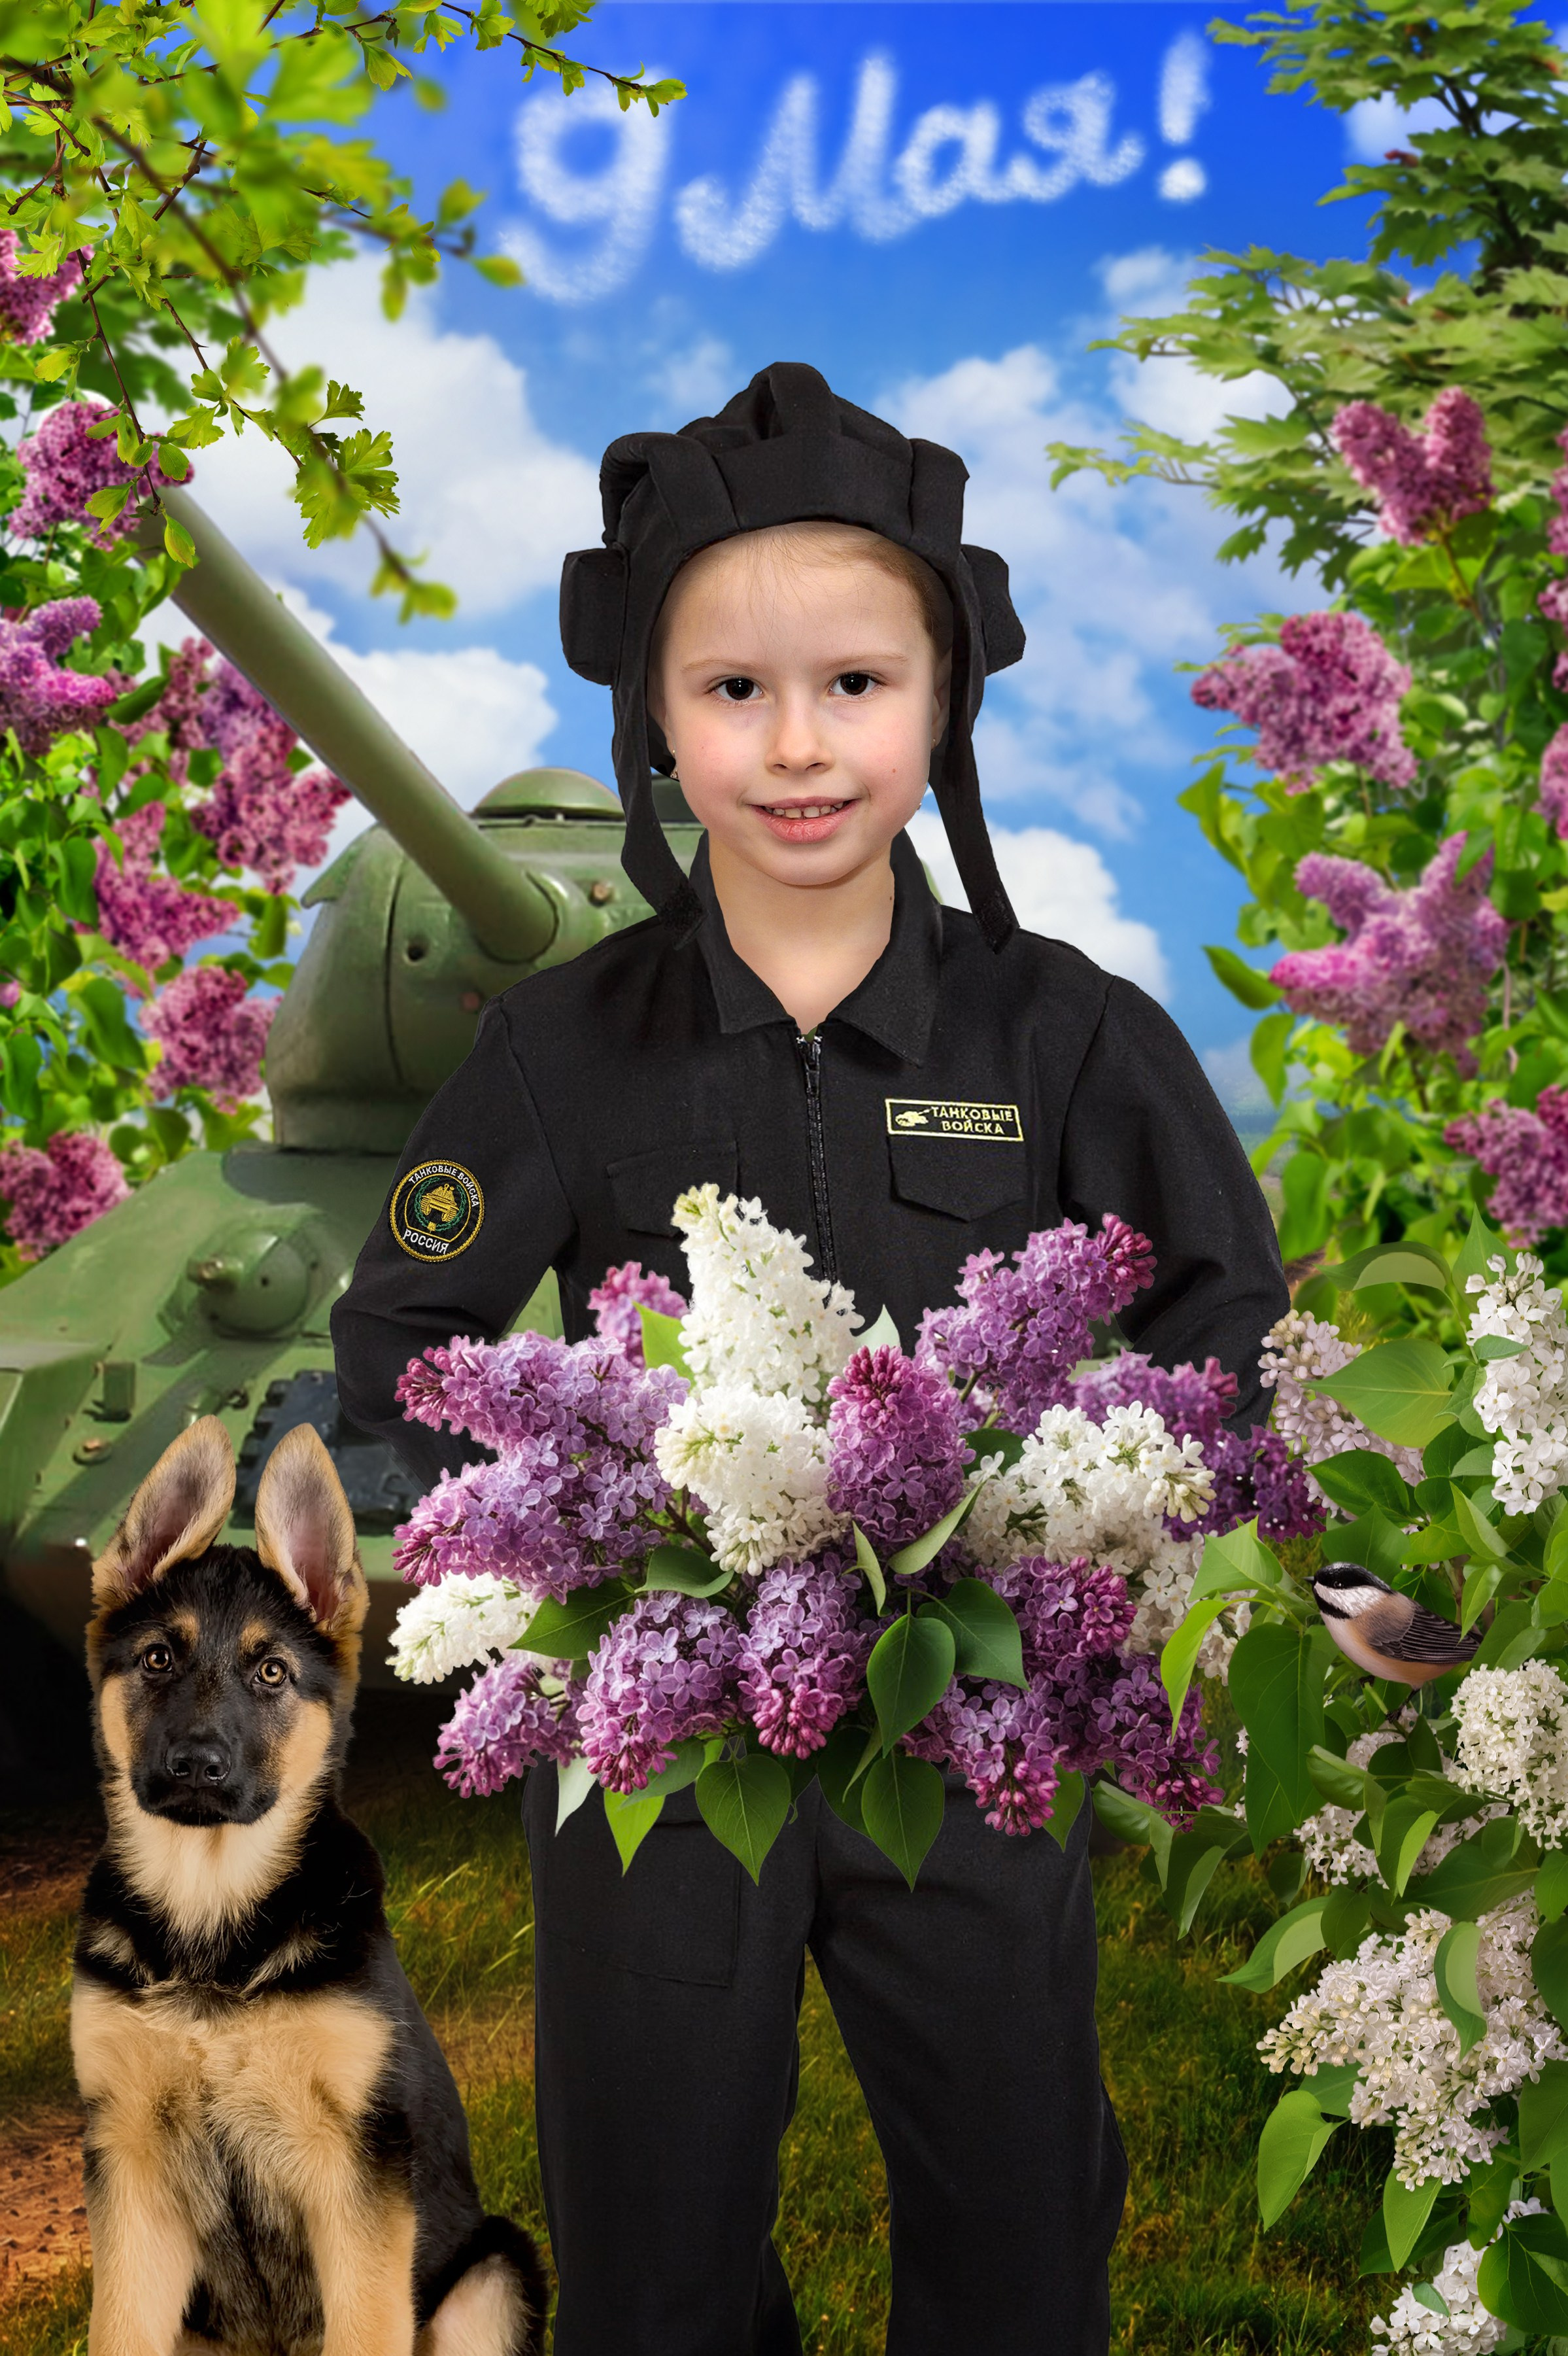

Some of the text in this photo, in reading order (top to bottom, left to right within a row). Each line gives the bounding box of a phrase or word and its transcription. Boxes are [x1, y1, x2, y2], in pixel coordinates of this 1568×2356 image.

[500, 33, 1210, 302] 9 Мая!
[931, 1106, 1014, 1122] ТАНКОВЫЕ
[942, 1119, 1005, 1135] ВОЙСКА
[408, 1165, 458, 1185] ТАНКОВЫЕ
[402, 1228, 449, 1255] РОССИЯ
